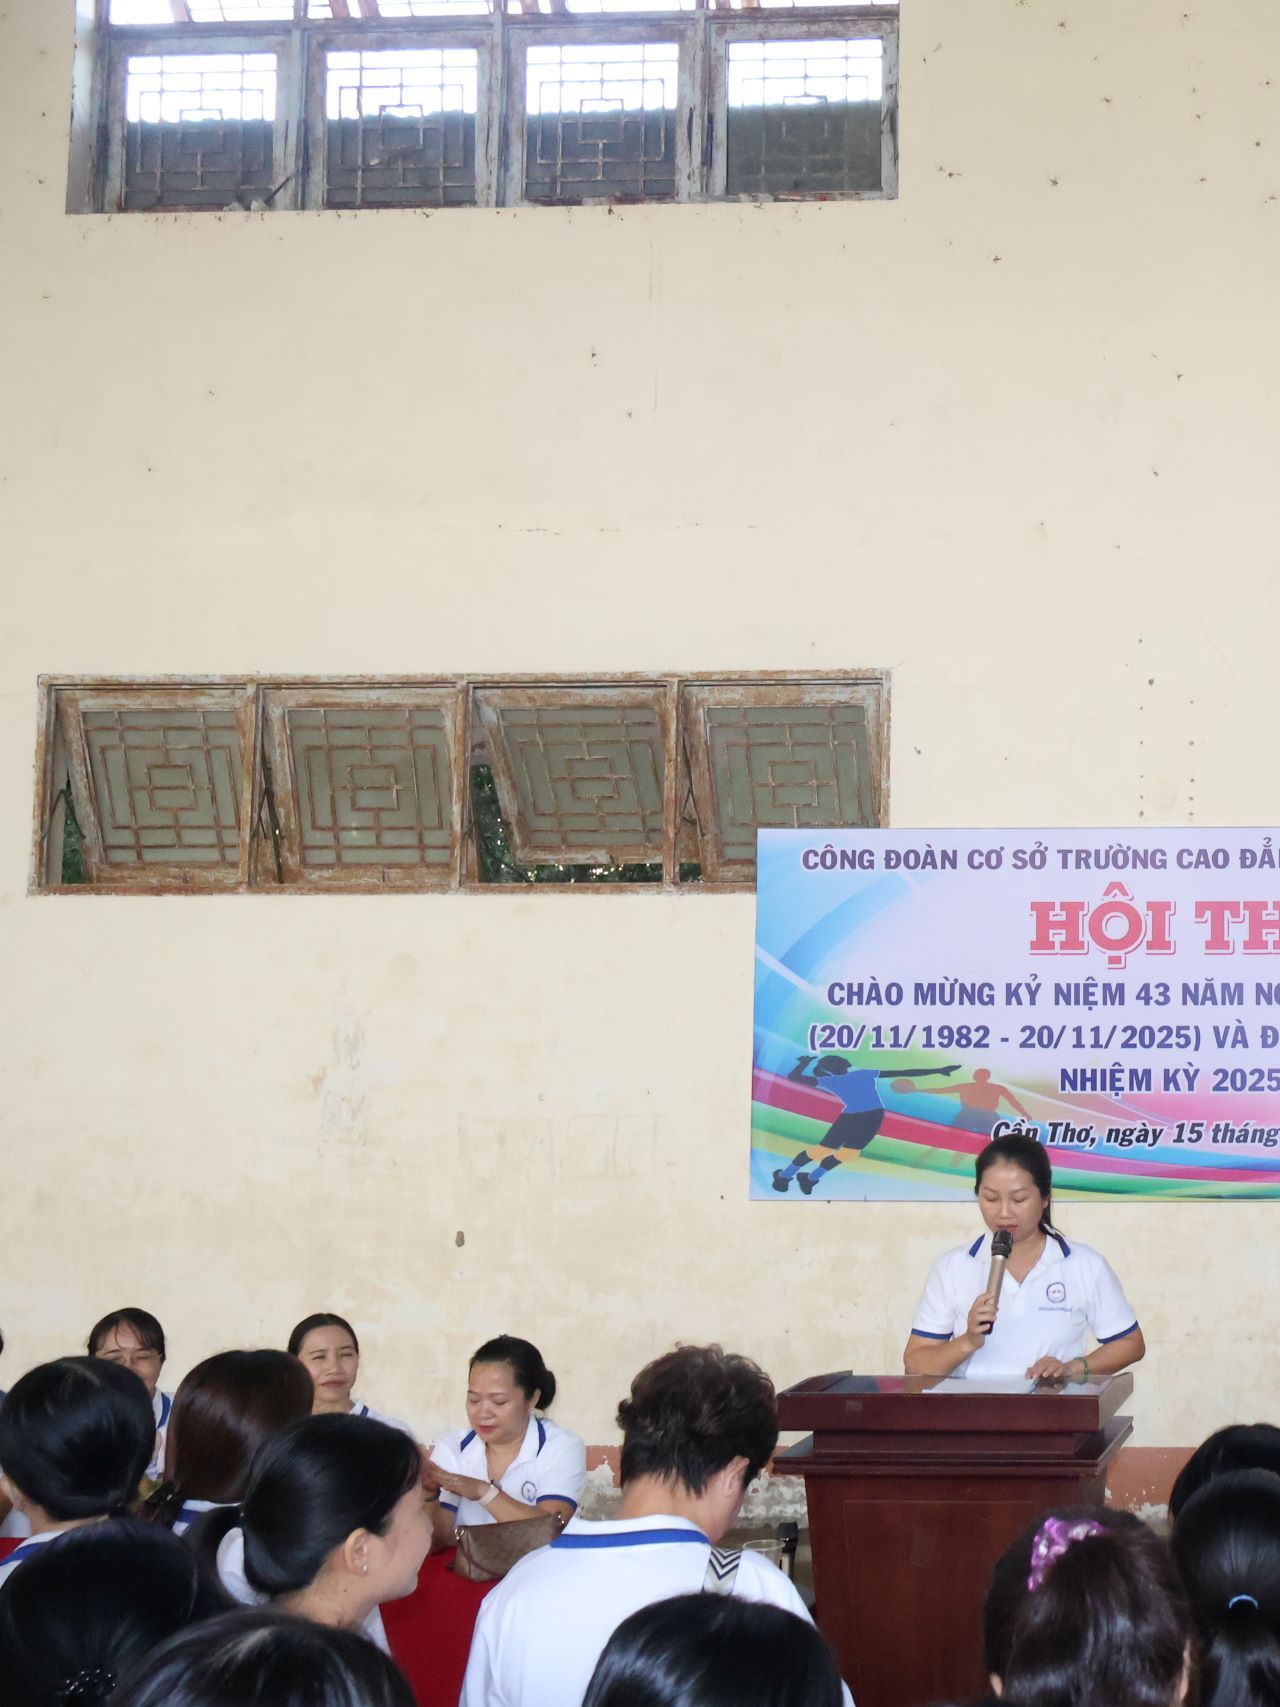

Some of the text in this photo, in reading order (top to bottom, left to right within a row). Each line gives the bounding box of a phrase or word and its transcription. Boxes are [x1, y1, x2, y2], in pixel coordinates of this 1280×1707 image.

[802, 843, 875, 871] CÔNG
[884, 843, 958, 871] ĐOÀN
[967, 846, 1003, 870] CƠ
[1012, 841, 1048, 870] SỞ
[1057, 842, 1167, 871] TRƯỜNG
[1176, 848, 1230, 870] CAO
[1029, 881, 1176, 969] HỘI
[827, 976, 903, 1006] CHÀO
[914, 976, 995, 1006] MỪNG
[1005, 973, 1042, 1006] KỶ
[1054, 977, 1125, 1011] NIỆM
[1135, 982, 1171, 1006] 43
[1182, 976, 1244, 1006] NĂM
[808, 1024, 990, 1051] (20/11/1982
[1018, 1024, 1202, 1051] 20/11/2025)
[1213, 1019, 1249, 1049] VÀ
[1060, 1063, 1152, 1097] NHIỆM
[1163, 1063, 1200, 1092] KỲ
[1048, 1121, 1096, 1147] Thơ,
[1106, 1121, 1164, 1148] ngày
[1174, 1122, 1205, 1144] 15
[1212, 1121, 1280, 1147] tháng
